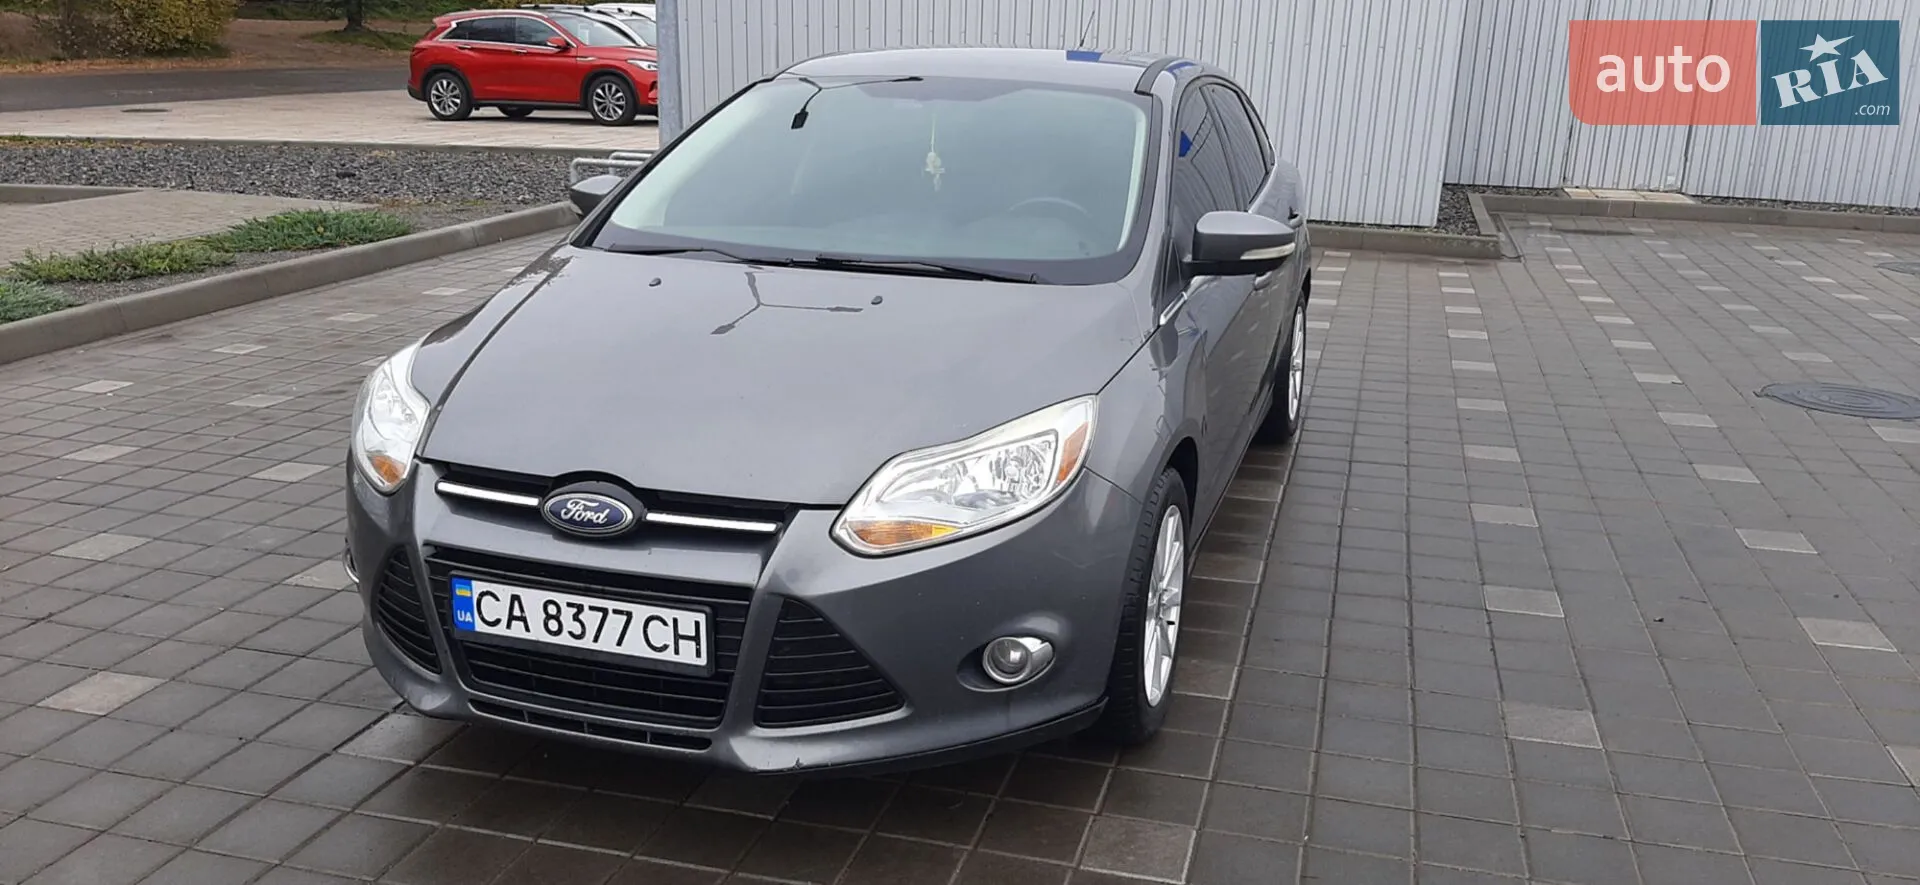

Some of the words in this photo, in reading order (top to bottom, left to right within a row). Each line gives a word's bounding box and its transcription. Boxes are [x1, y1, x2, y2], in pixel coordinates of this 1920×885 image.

[560, 498, 610, 524] Ford
[457, 609, 473, 623] UA
[475, 589, 531, 633] CA
[542, 599, 633, 647] 8377
[642, 614, 702, 659] CH
